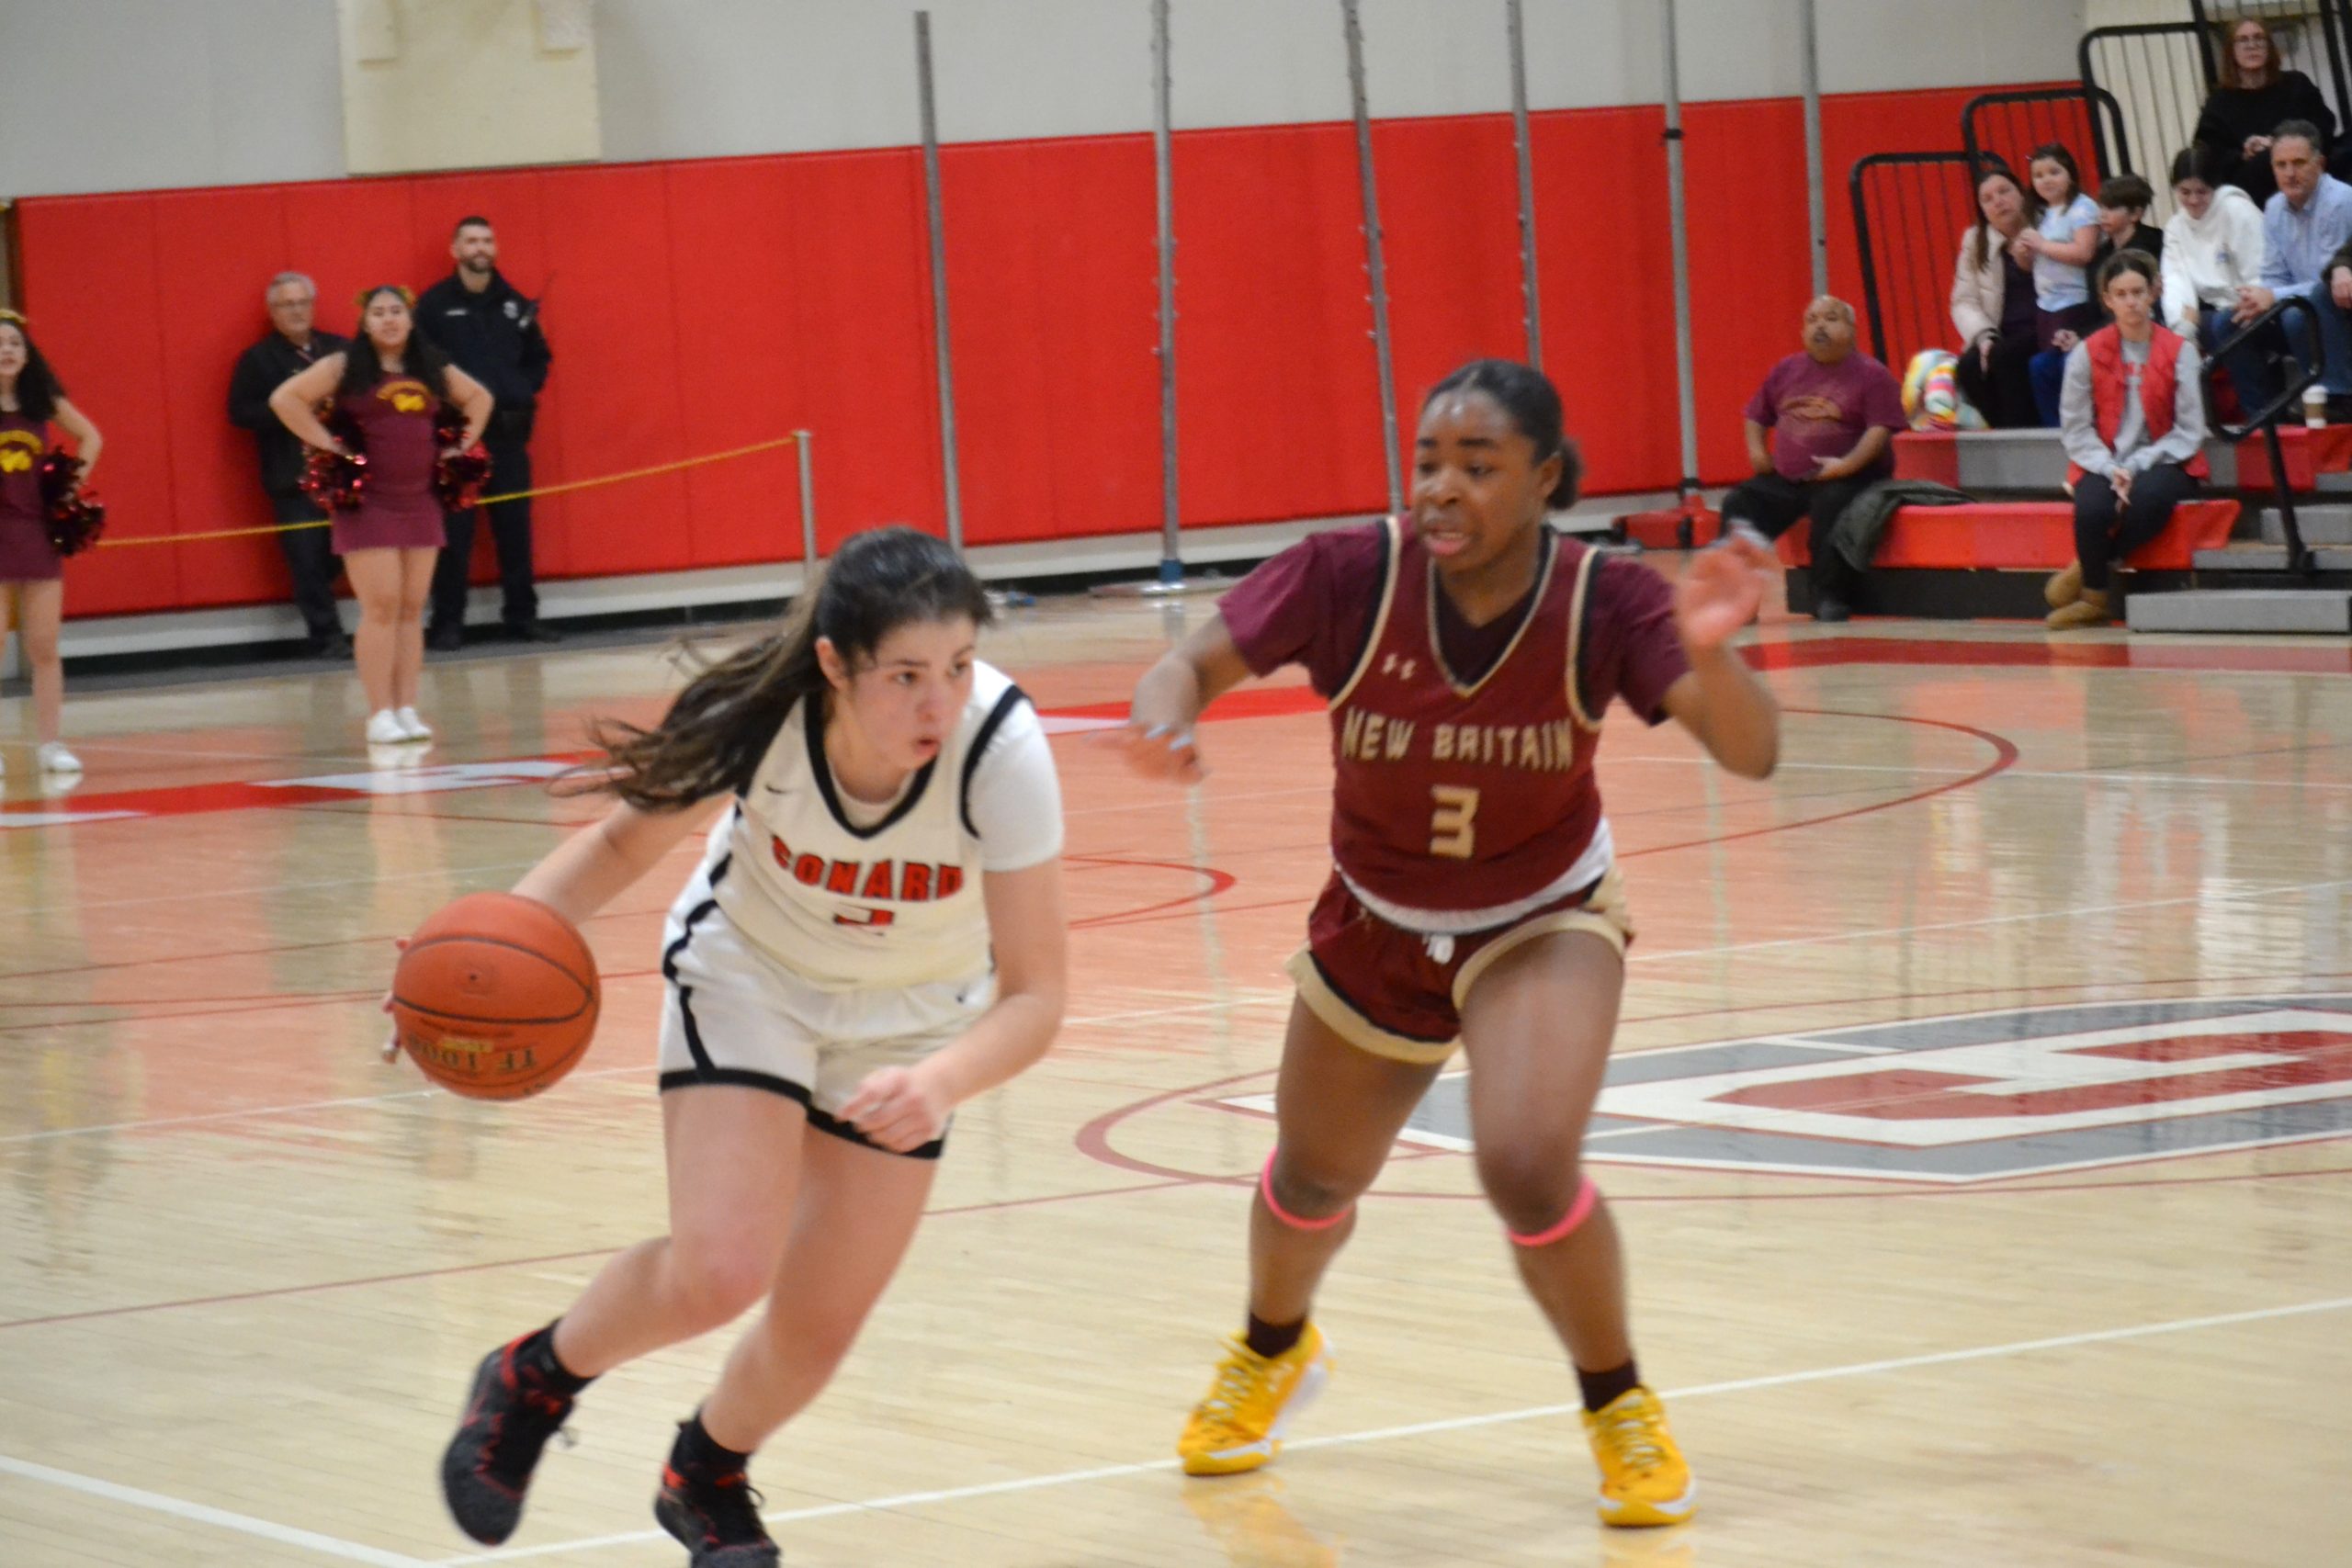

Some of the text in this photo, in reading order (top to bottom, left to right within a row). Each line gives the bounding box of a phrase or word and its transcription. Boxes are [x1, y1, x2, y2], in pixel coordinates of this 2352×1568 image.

[1341, 706, 1574, 772] NEW BRITAIN
[1430, 784, 1480, 859] 3
